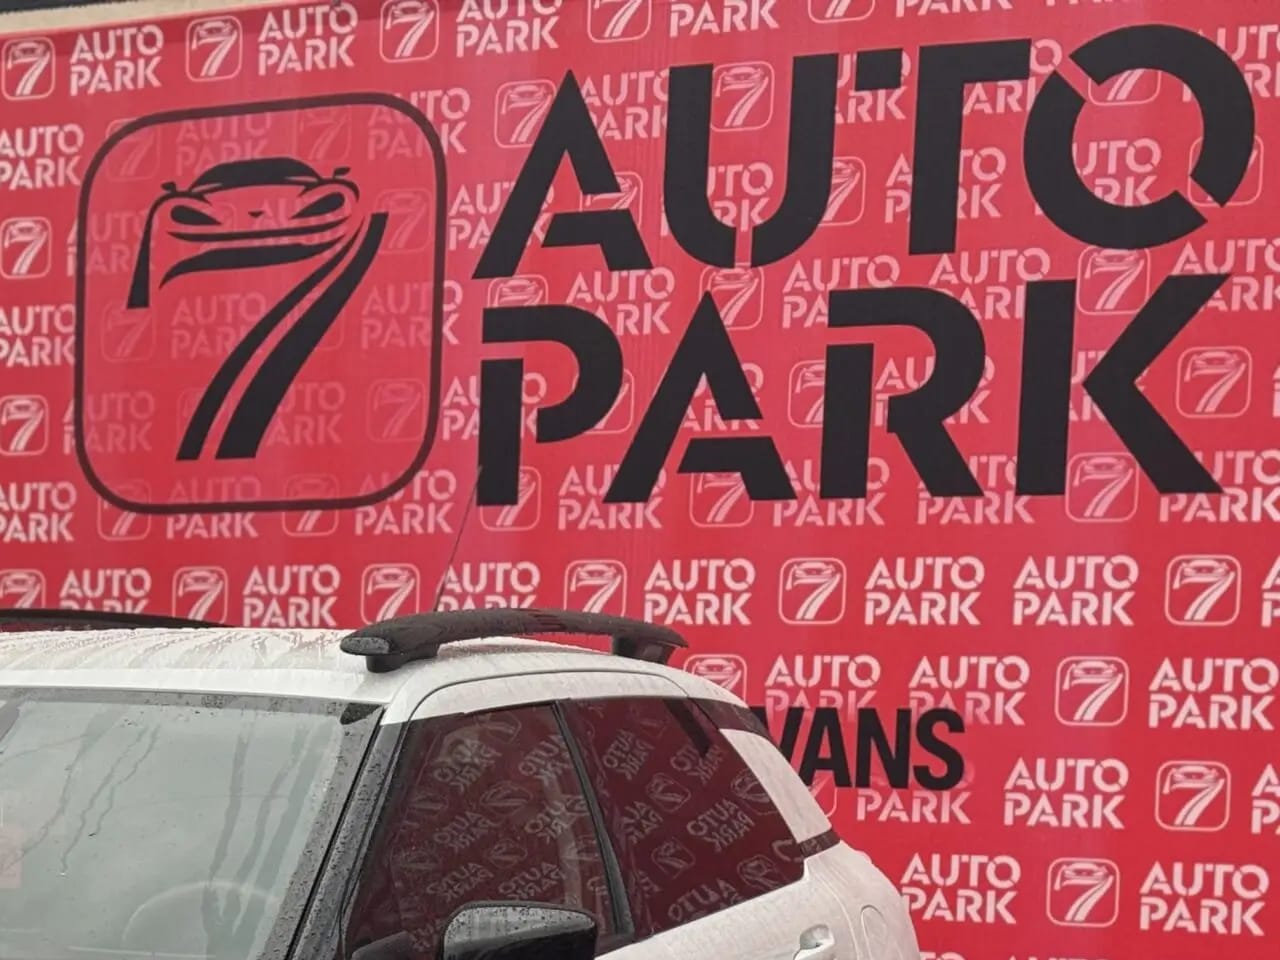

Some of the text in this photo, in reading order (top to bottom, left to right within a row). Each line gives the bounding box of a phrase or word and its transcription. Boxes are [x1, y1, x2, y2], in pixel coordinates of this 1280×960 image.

[258, 3, 358, 42] AUTO
[456, 15, 560, 57] PARK
[670, 0, 779, 38] PARK
[70, 24, 164, 63] AUTO
[258, 35, 354, 76] PARK
[70, 57, 162, 96] PARK
[473, 23, 1255, 280] AUTO
[782, 254, 900, 293] AUTO
[928, 246, 1050, 287] AUTO
[566, 267, 676, 303] AUTO
[476, 272, 1232, 506] PARK
[167, 510, 259, 539] PARK
[354, 503, 454, 536] PARK
[558, 497, 662, 531] PARK
[773, 492, 885, 527] PARK
[917, 491, 1035, 526] PARK
[59, 568, 152, 597] AUTO
[243, 564, 340, 596] AUTO
[440, 562, 540, 594] AUTO
[644, 558, 755, 592] AUTO
[864, 557, 986, 590] AUTO
[1013, 555, 1139, 590] AUTO
[243, 596, 336, 627] PARK
[644, 592, 752, 626] PARK
[864, 591, 981, 626] PARK
[1013, 592, 1134, 627] PARK
[765, 655, 881, 689] AUTO
[909, 655, 1030, 690] AUTO
[1149, 657, 1280, 694] AUTO
[1149, 694, 1276, 731] PARK
[1004, 758, 1129, 793] AUTO
[856, 789, 972, 824] PARK
[1003, 794, 1125, 829] PARK
[901, 853, 1021, 889] AUTO
[1140, 861, 1269, 899] AUTO
[902, 888, 1016, 925] PARK
[1140, 898, 1265, 936] PARK
